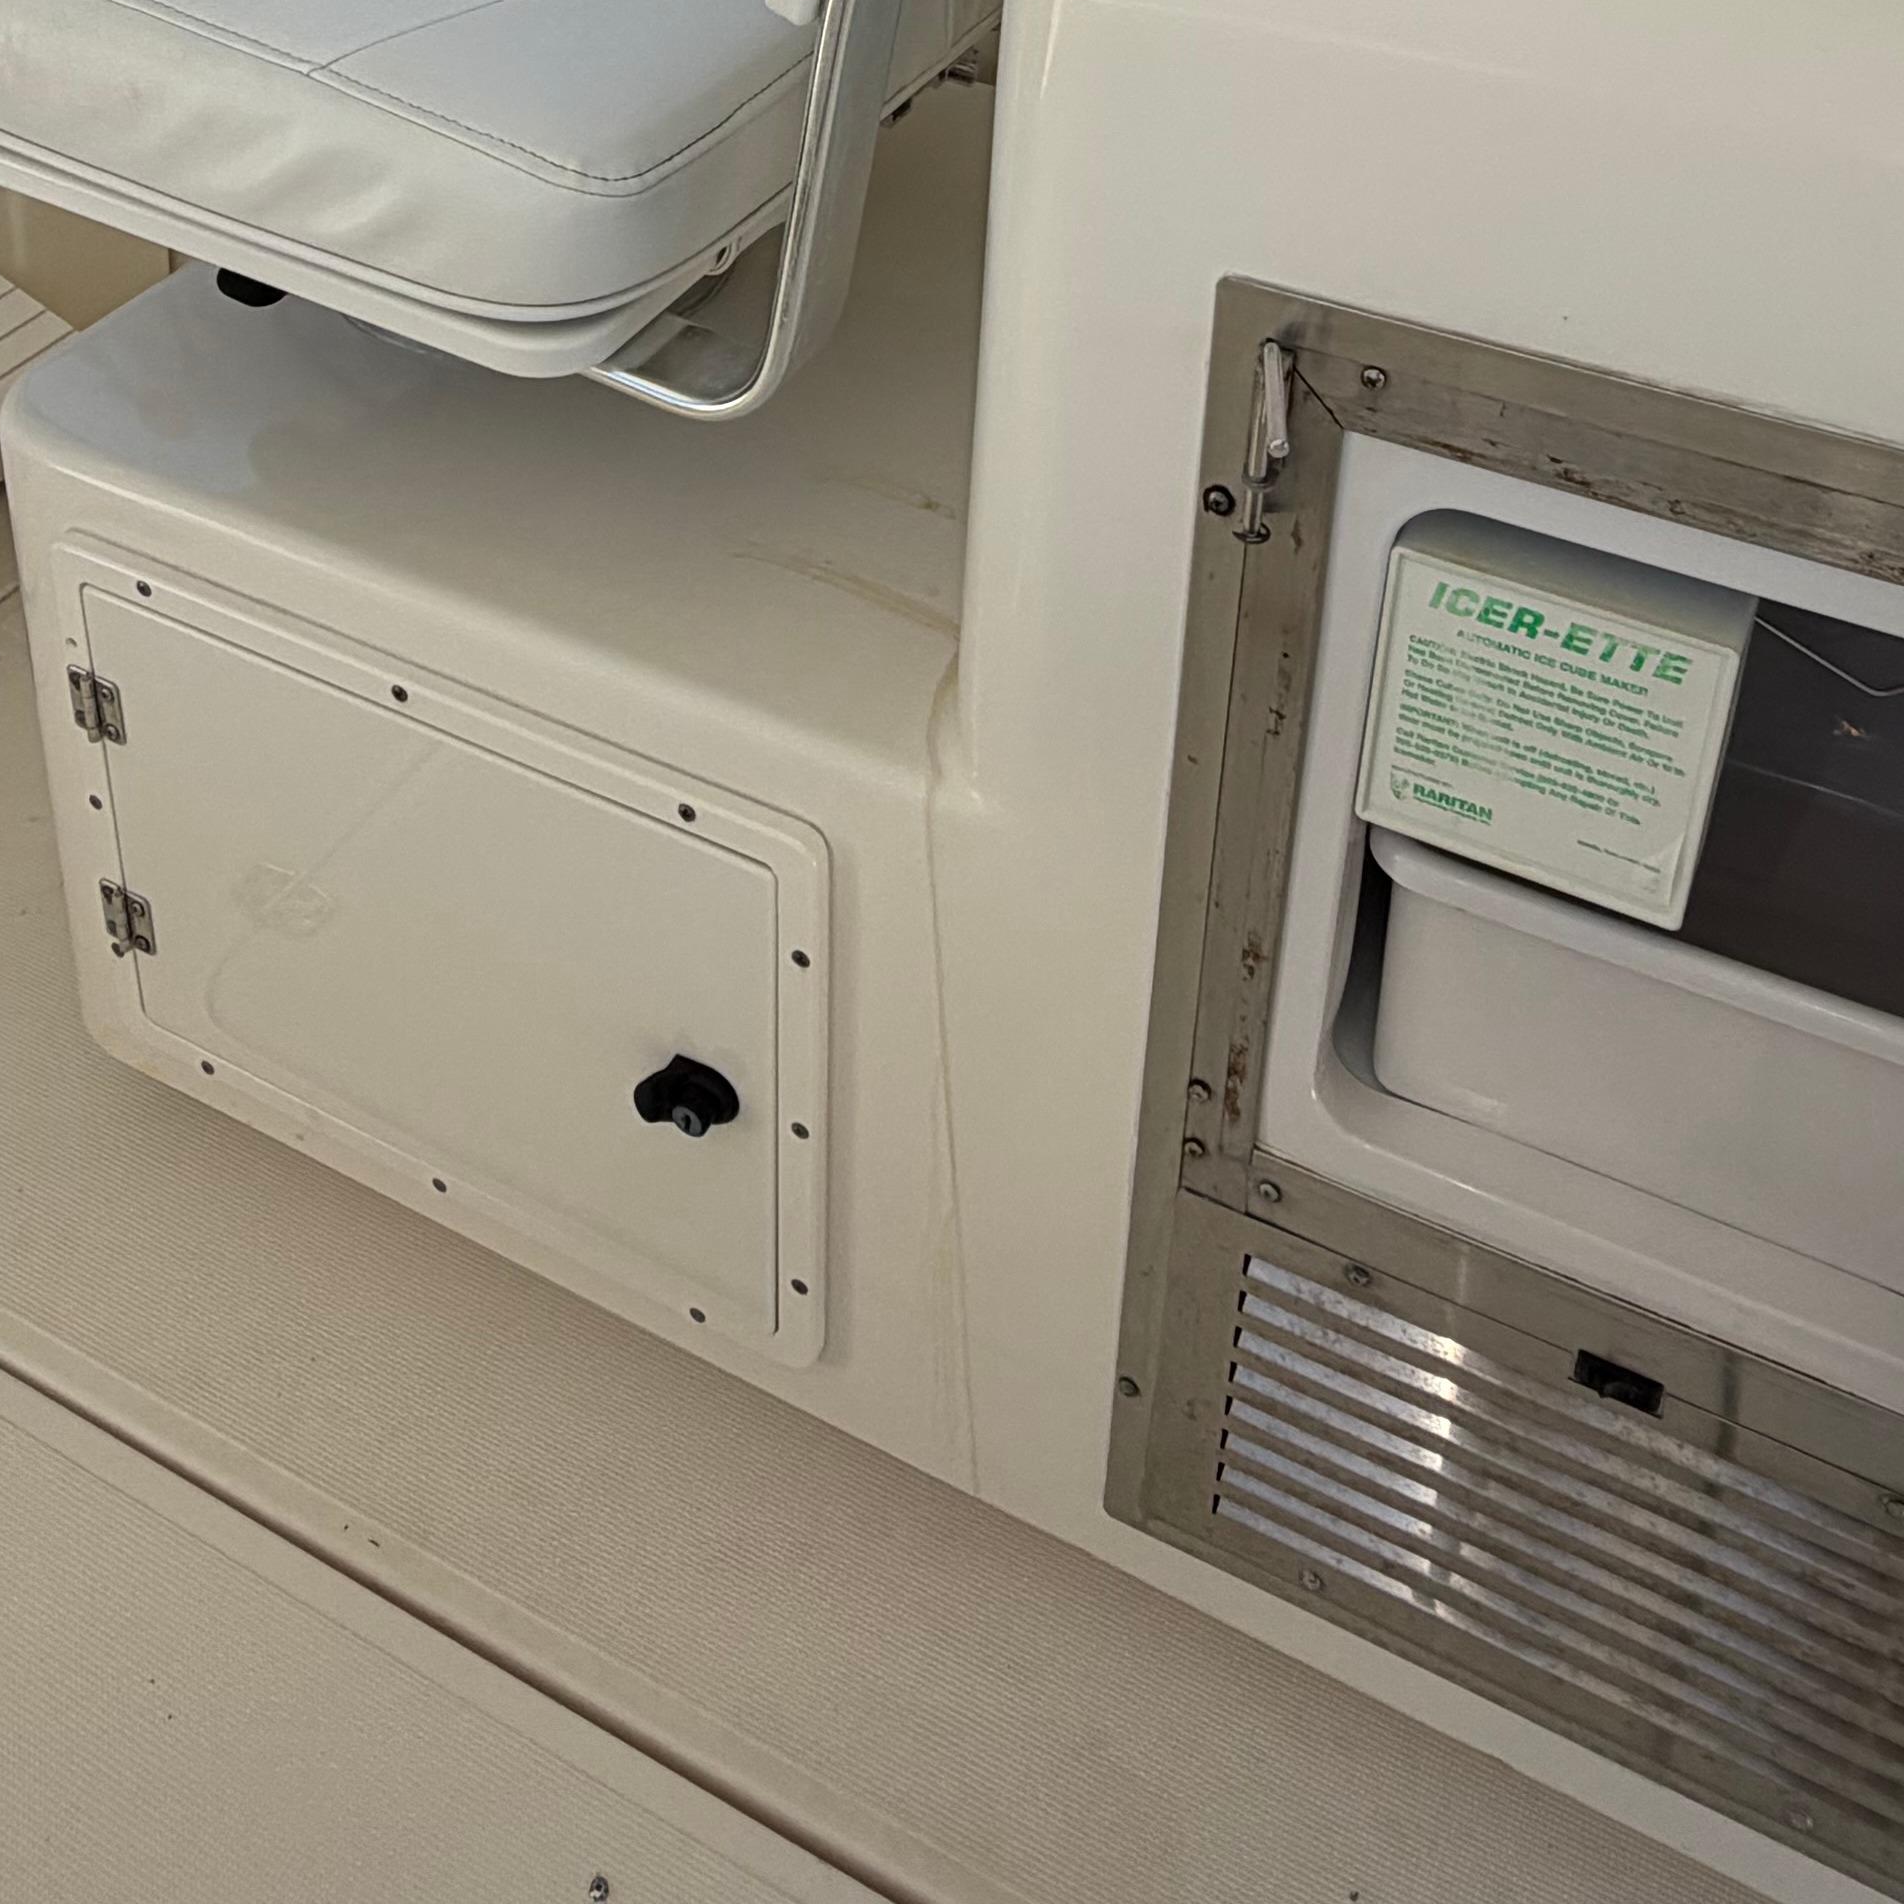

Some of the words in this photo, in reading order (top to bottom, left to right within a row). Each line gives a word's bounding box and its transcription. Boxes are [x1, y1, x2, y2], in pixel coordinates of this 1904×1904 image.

[1428, 580, 1694, 687] ICER-ETTE
[1456, 629, 1531, 659] AUTOMATIC
[1533, 653, 1556, 668] ICE
[1559, 661, 1596, 680] CUBE
[1600, 673, 1648, 696] MAKER
[1412, 783, 1492, 820] RARITAN
